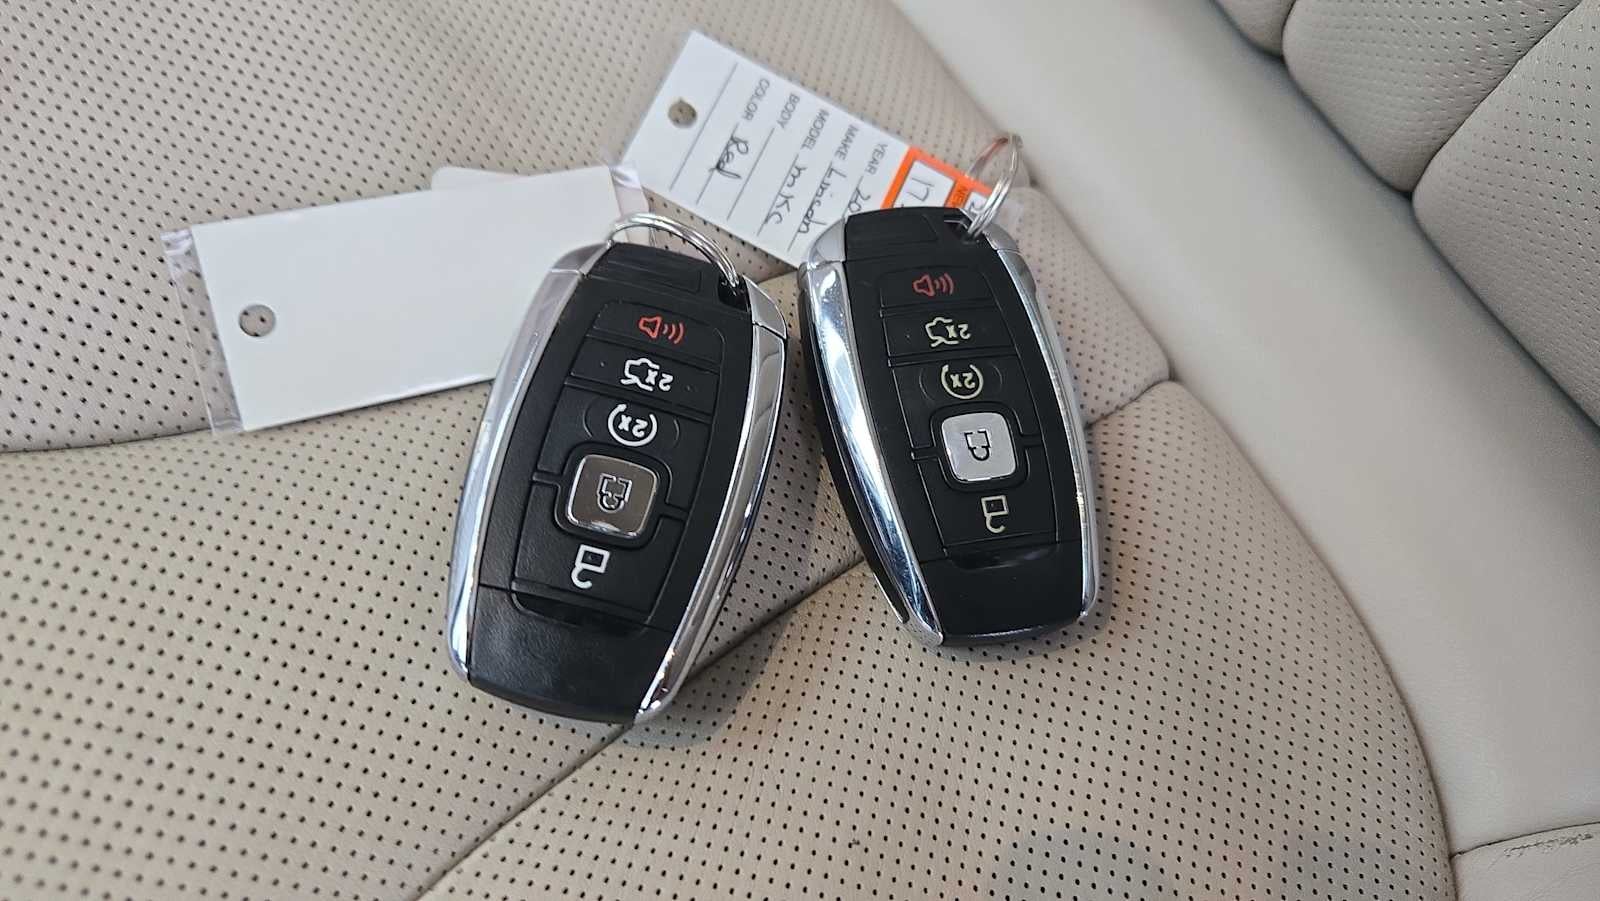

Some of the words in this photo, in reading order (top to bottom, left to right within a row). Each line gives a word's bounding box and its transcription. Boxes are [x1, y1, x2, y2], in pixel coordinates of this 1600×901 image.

[742, 78, 770, 121] COLOR
[777, 93, 800, 129] BODY
[801, 108, 830, 150] MODEL
[834, 124, 859, 160] MAKE
[708, 133, 749, 179] Red
[864, 143, 888, 175] YEAR
[847, 187, 872, 214] 20
[901, 177, 935, 207] 17
